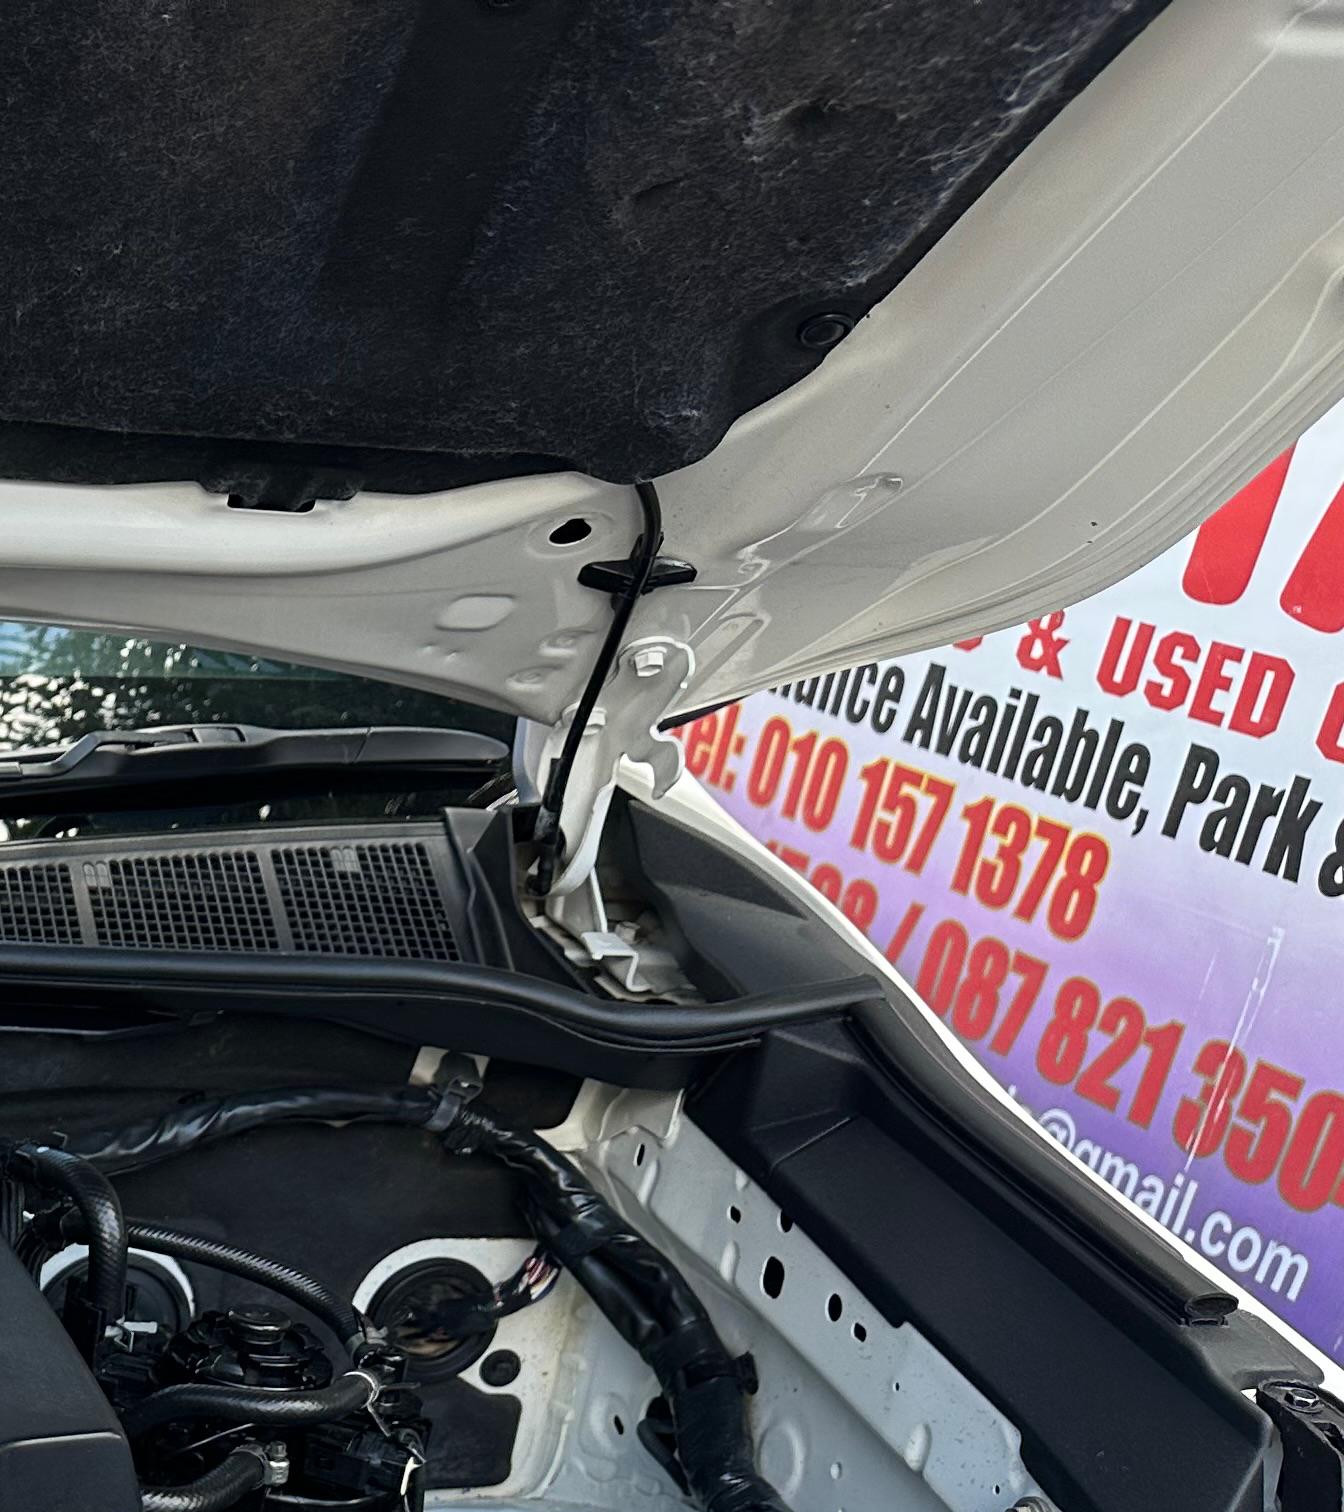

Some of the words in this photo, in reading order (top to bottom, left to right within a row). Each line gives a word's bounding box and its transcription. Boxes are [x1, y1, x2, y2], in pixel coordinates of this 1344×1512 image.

[902, 660, 1150, 838] Available,
[1161, 742, 1324, 884] Park
[1096, 615, 1296, 739] USED
[672, 703, 747, 796] el:
[746, 714, 850, 833] 010
[850, 755, 957, 877] 157
[949, 795, 1111, 943] 1378
[916, 918, 1050, 1058] 087
[1035, 975, 1187, 1131] 821
[1172, 1038, 1344, 1214] 350
